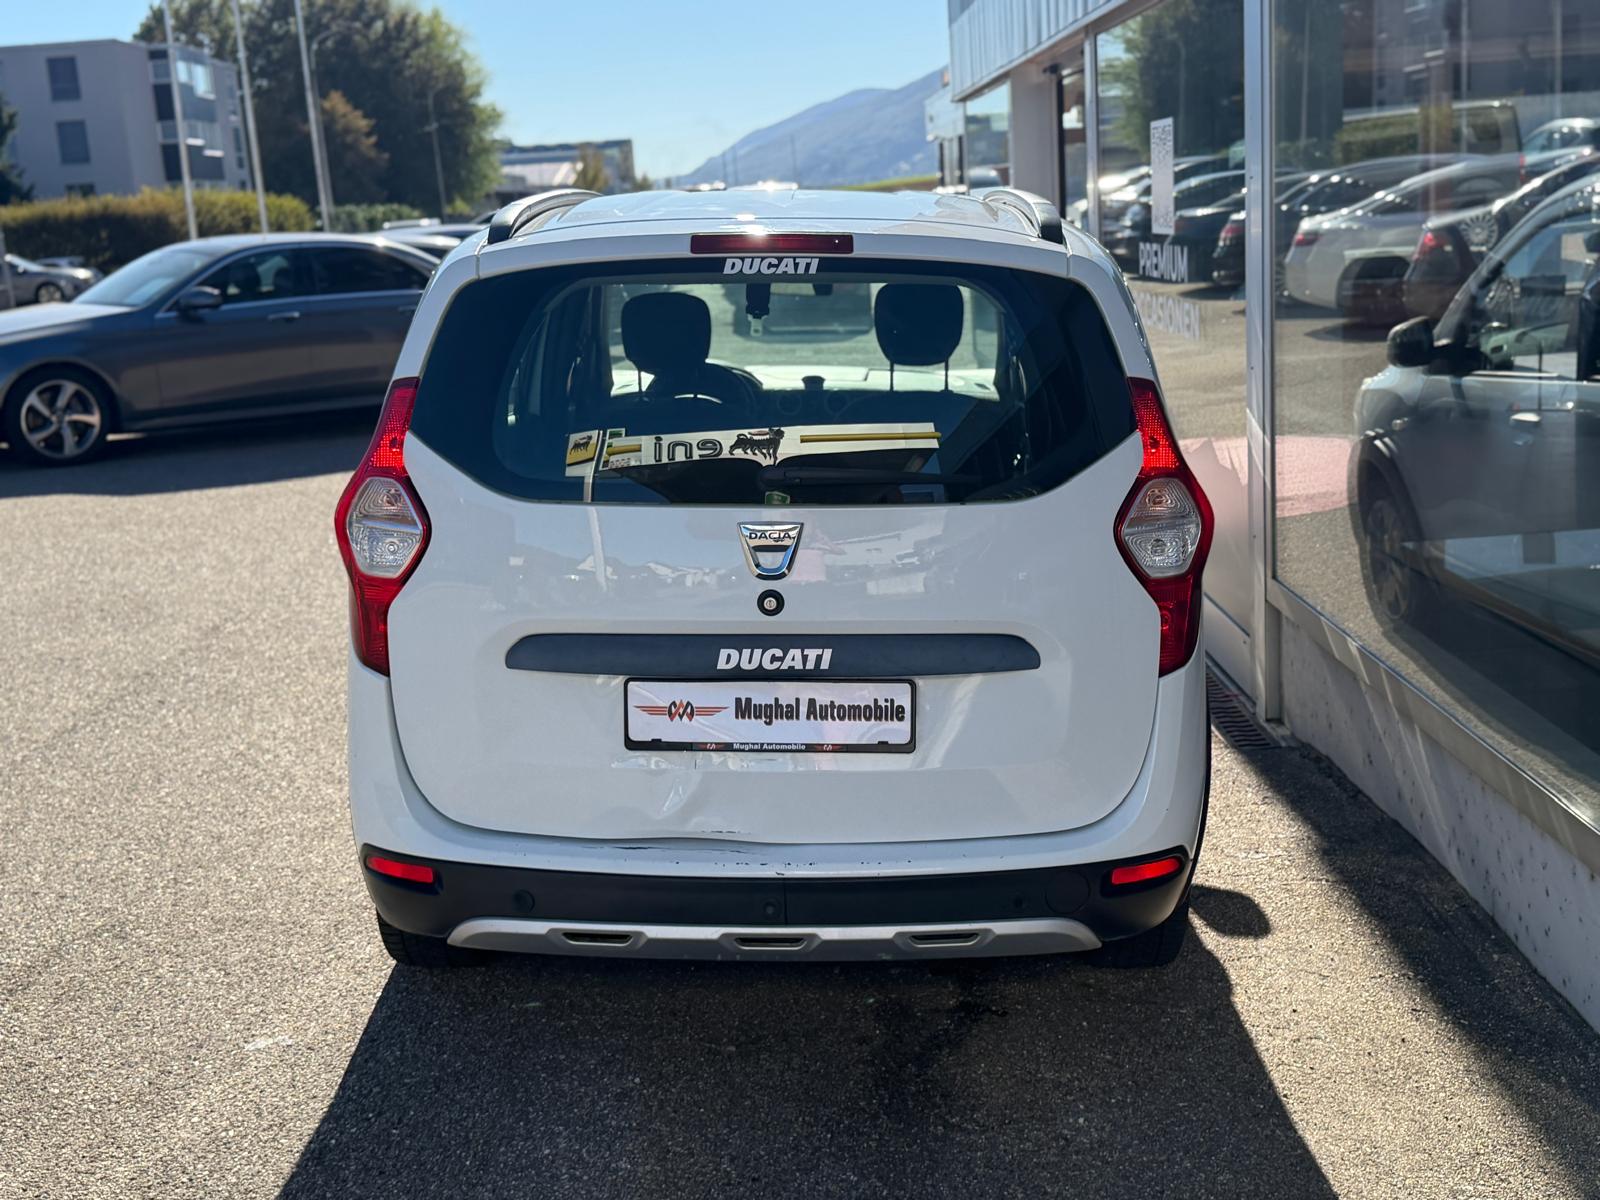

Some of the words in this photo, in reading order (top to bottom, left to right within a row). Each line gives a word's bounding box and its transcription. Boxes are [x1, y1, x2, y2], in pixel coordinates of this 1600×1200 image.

[722, 257, 820, 275] DUCATI
[1138, 242, 1189, 282] PREMIUM
[748, 531, 793, 541] DACIA
[716, 648, 833, 671] DUCATI
[734, 696, 801, 726] Mughal
[805, 698, 906, 723] Automobile
[732, 742, 761, 751] Mughal
[762, 743, 807, 751] Automobile
